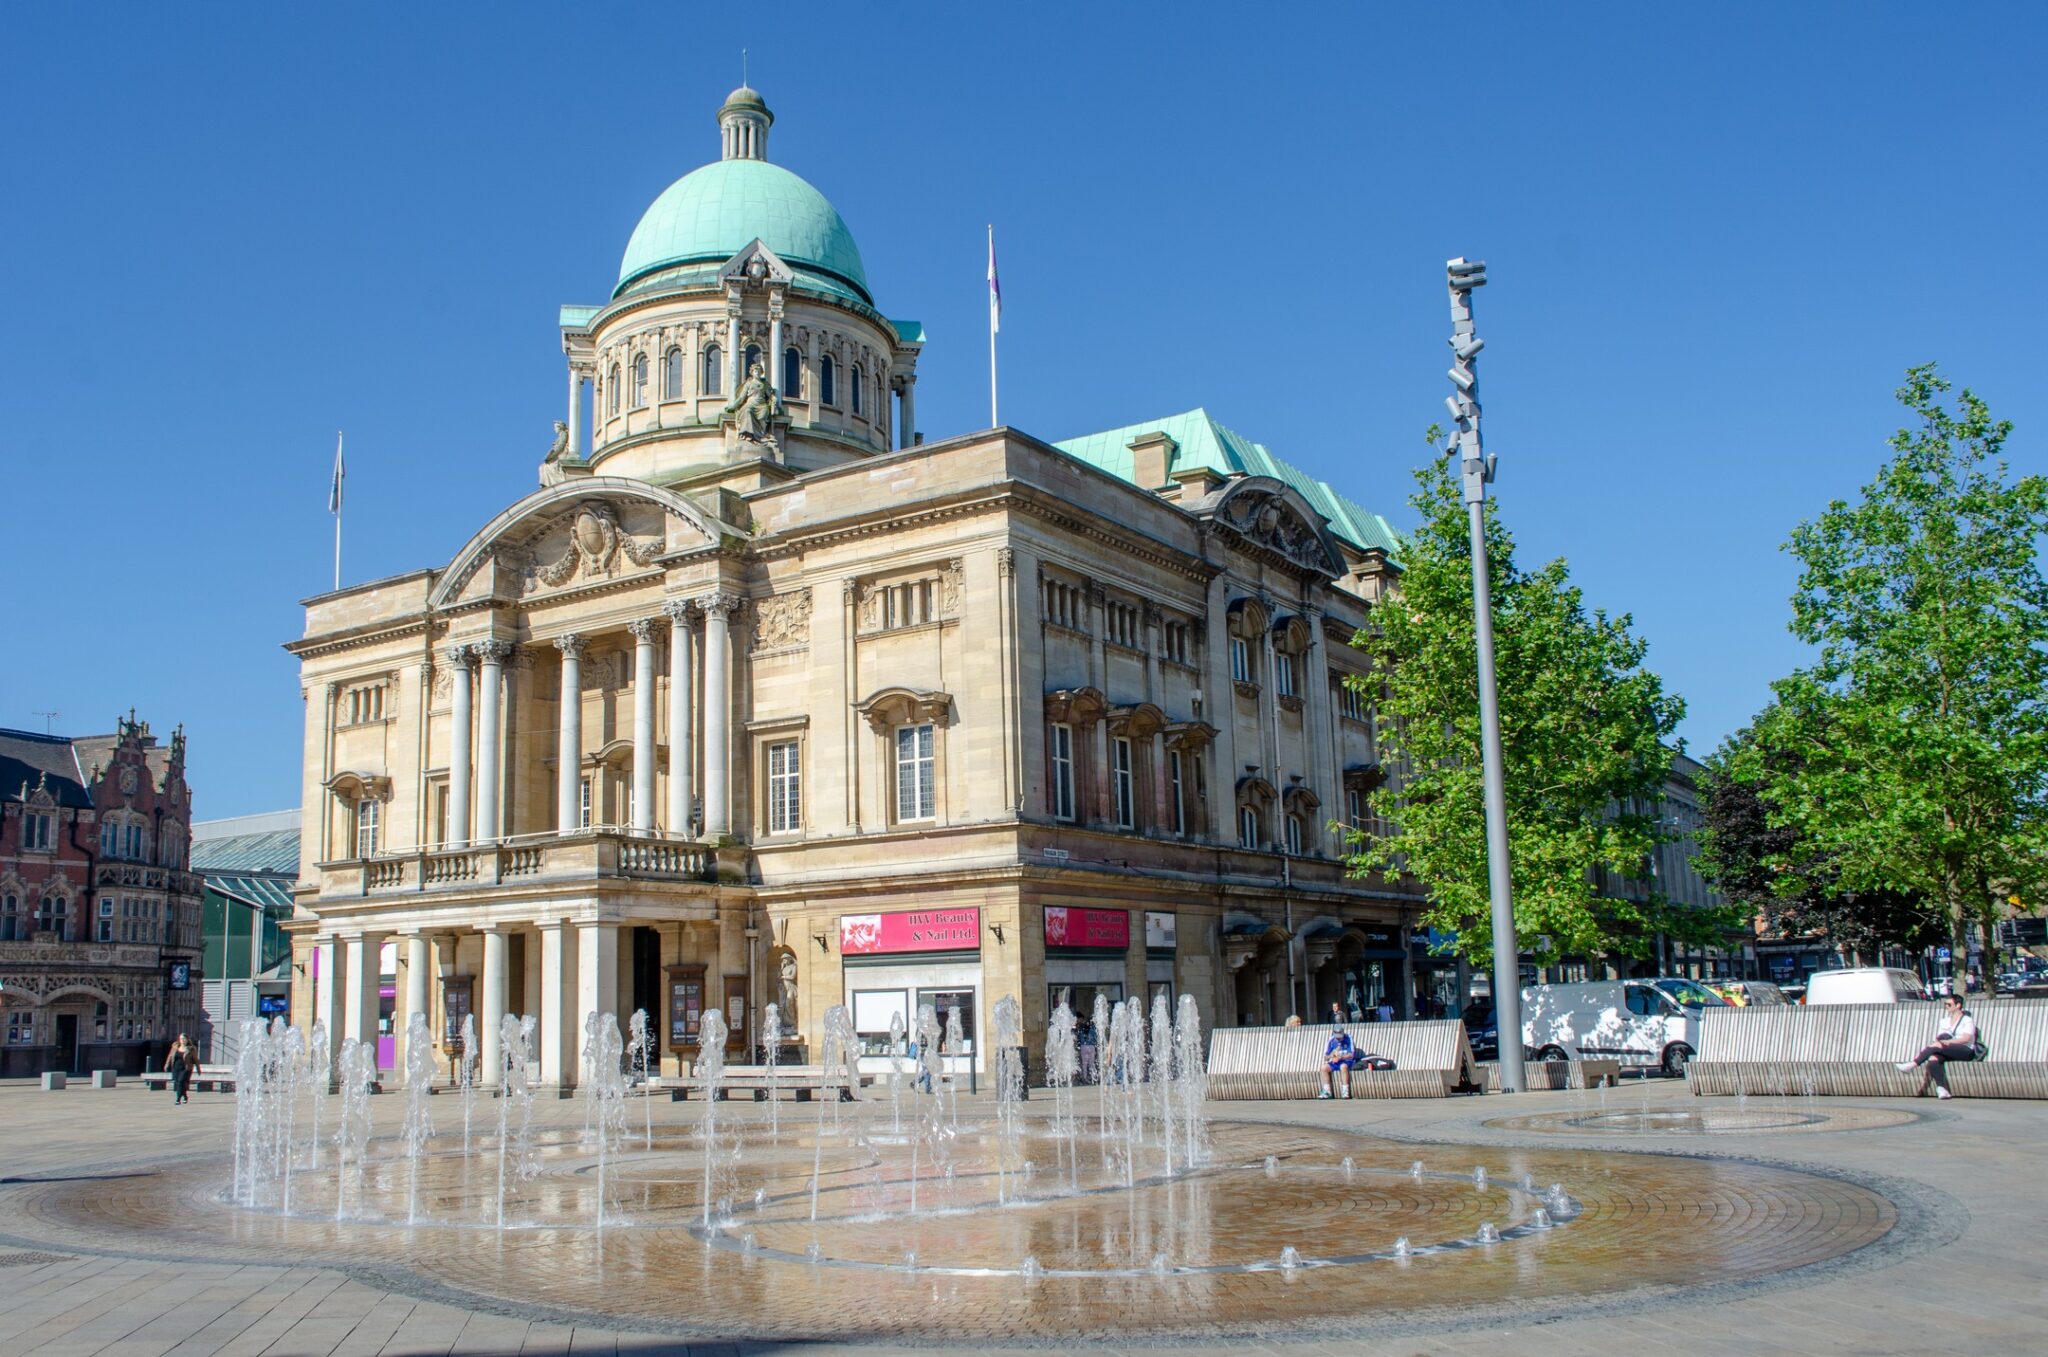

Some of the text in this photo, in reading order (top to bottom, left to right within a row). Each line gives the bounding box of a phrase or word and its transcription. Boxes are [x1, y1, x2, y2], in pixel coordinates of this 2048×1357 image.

[935, 912, 975, 924] Beauty
[912, 930, 922, 941] &
[927, 929, 948, 940] Nail
[951, 928, 975, 939] Ltd.
